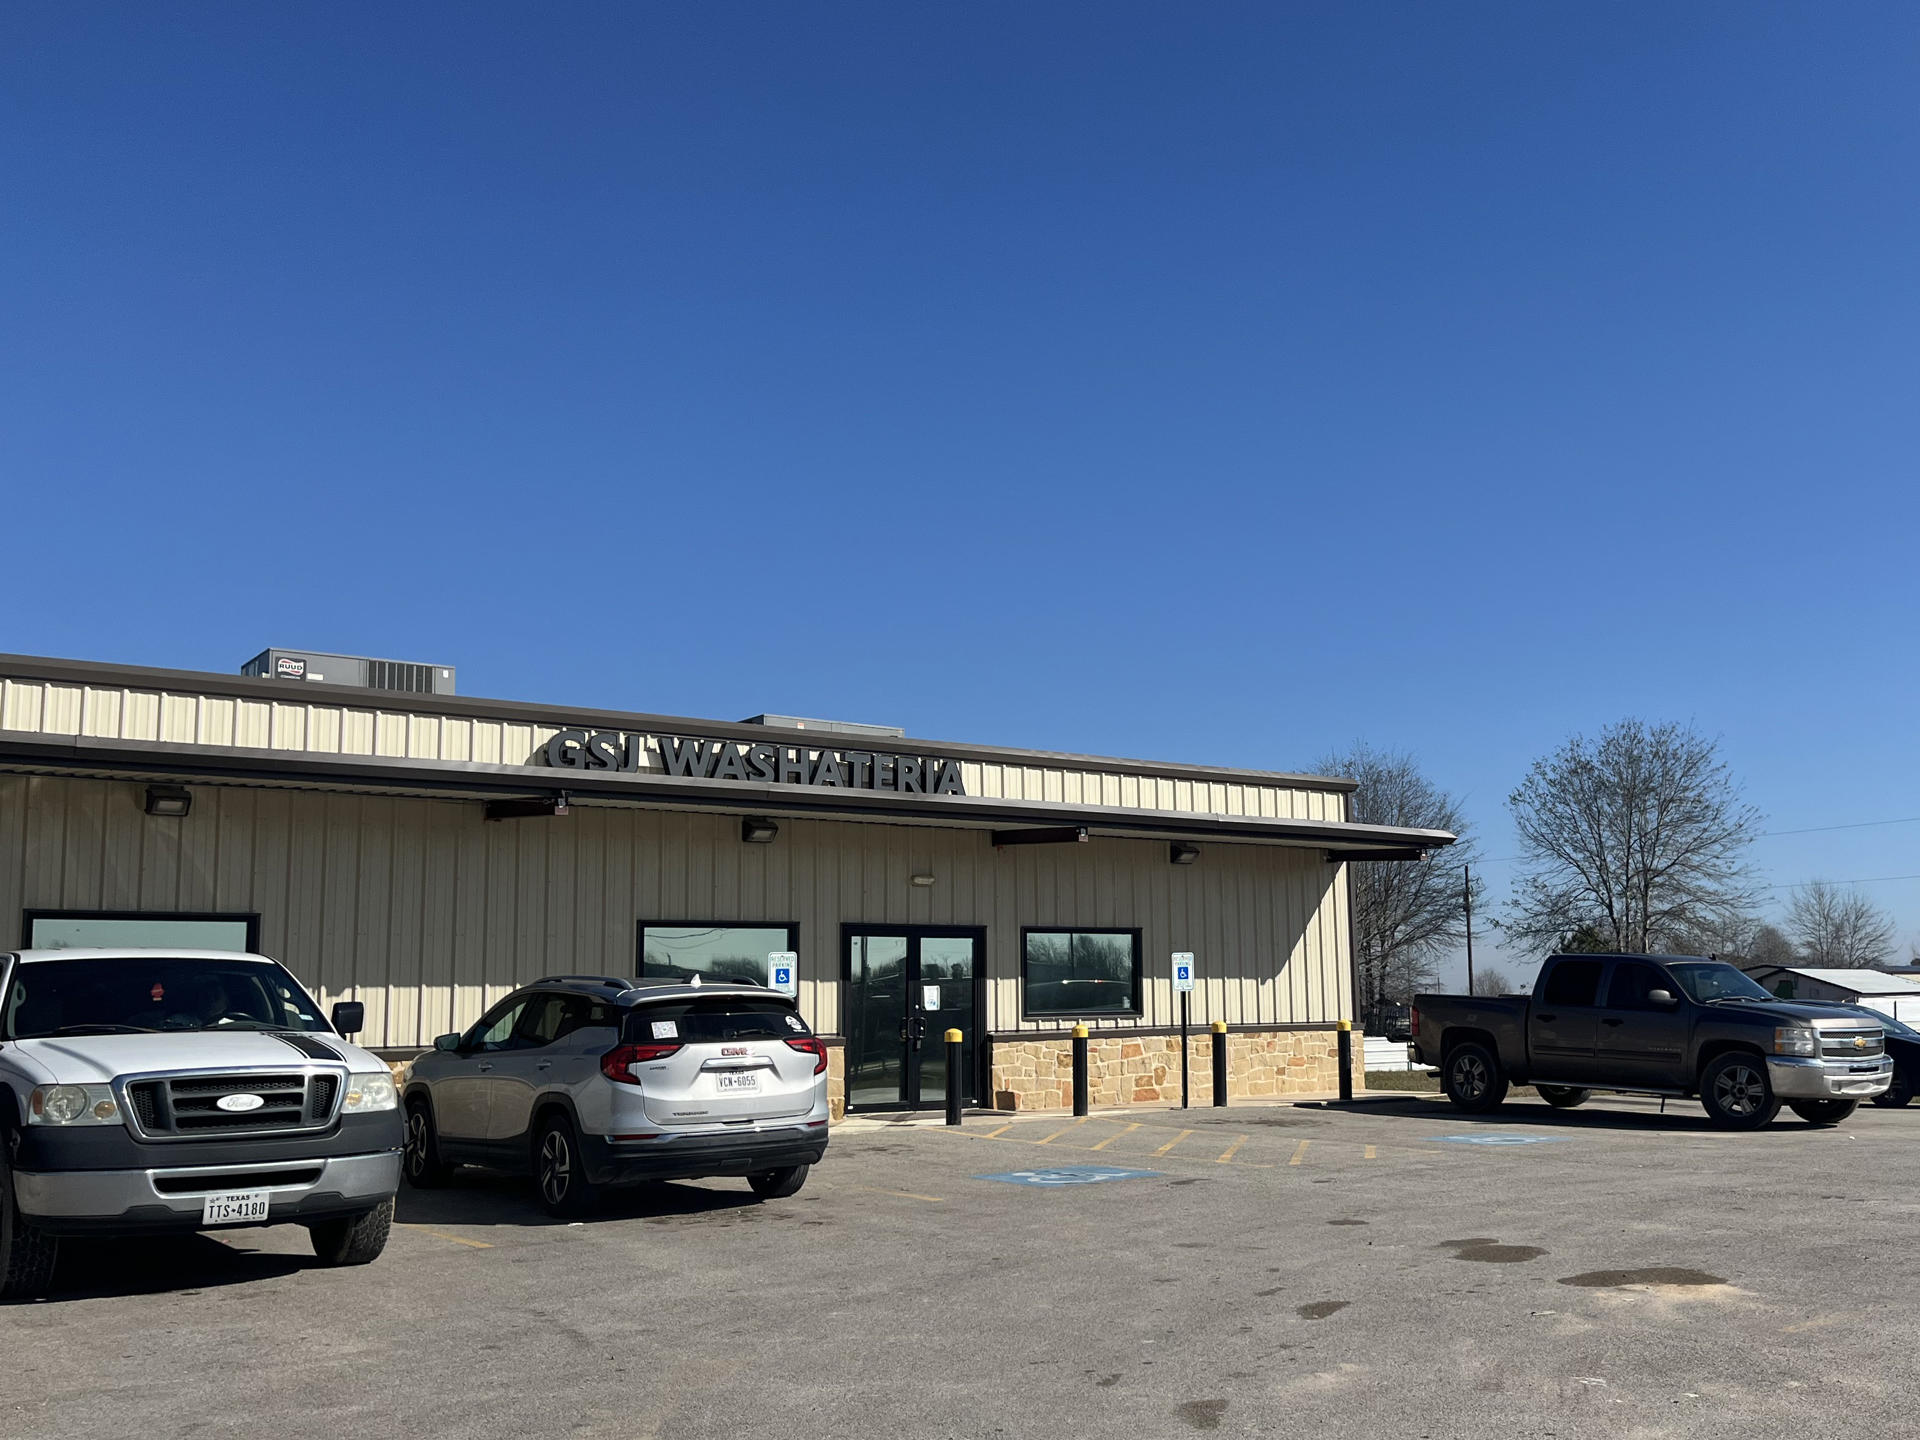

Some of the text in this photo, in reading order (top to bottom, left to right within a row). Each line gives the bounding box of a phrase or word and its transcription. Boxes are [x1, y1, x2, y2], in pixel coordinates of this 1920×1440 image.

[279, 663, 303, 671] RUUD
[547, 730, 967, 797] GSJ WASHATERIA
[226, 1194, 251, 1202] TEXAS
